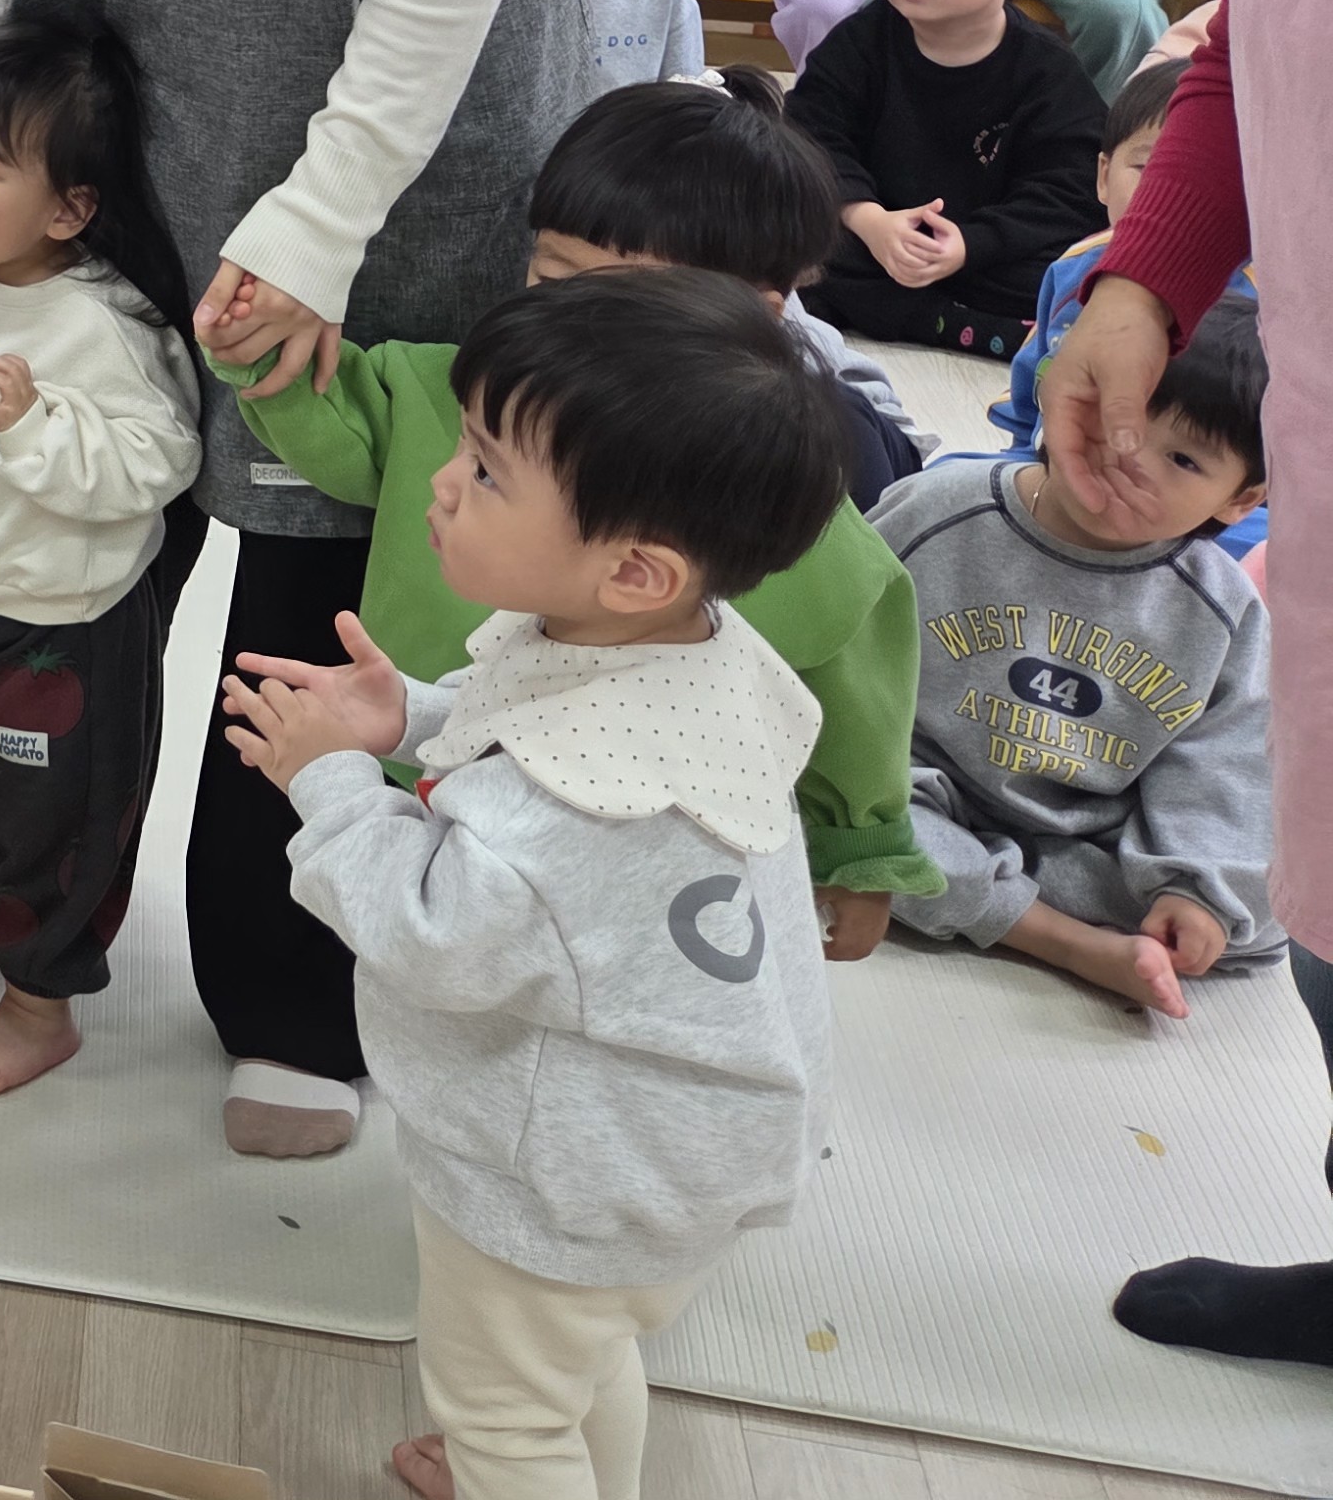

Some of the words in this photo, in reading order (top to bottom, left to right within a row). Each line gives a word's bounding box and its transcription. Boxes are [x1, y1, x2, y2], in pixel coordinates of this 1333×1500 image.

[928, 605, 1026, 660] WEST
[1048, 610, 1204, 733] VIRGINIA
[1029, 669, 1079, 710] 44
[0, 732, 38, 749] HAPPY
[956, 687, 1139, 771] ATHLETIC
[988, 734, 1086, 783] DEPT
